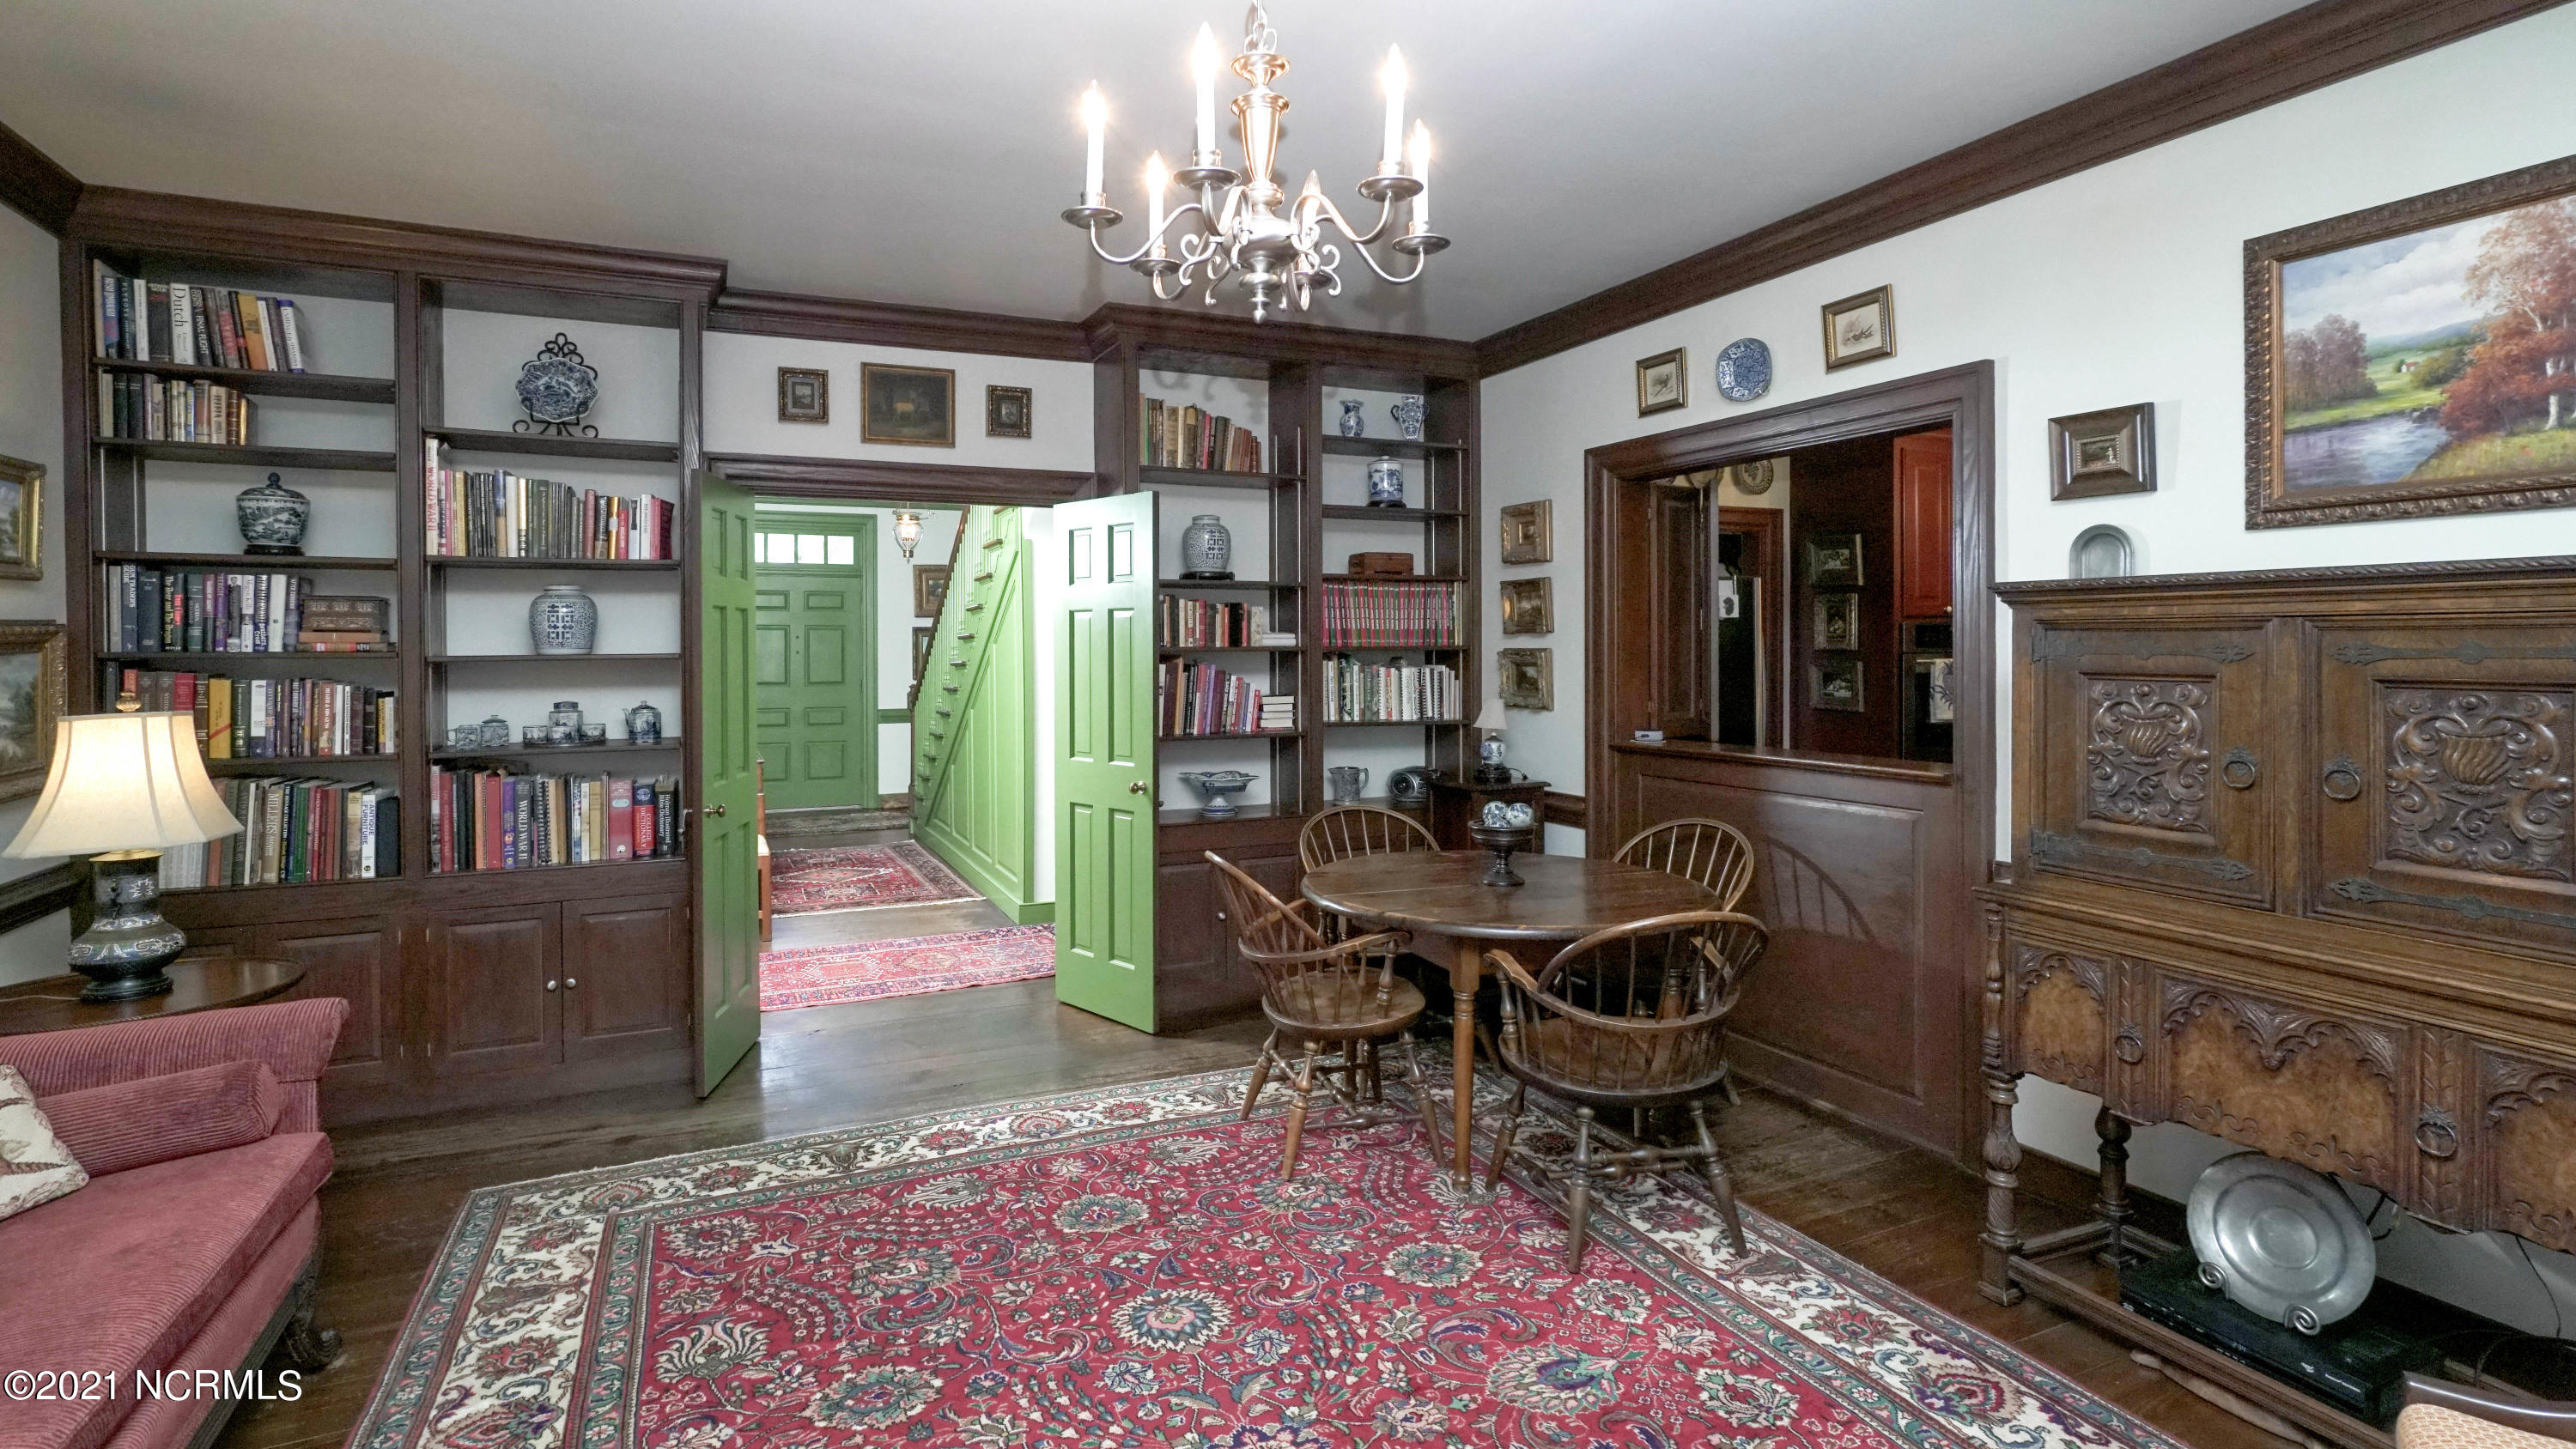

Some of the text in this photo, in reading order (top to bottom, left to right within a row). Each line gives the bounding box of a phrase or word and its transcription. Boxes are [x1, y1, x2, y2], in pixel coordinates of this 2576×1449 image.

[173, 288, 189, 328] Dutch
[196, 315, 209, 355] FINAL FLIGHT
[428, 502, 436, 524] WAR
[164, 576, 173, 644] The Bear and The Dragon
[518, 800, 528, 831] WORLD
[518, 832, 528, 852] WAR
